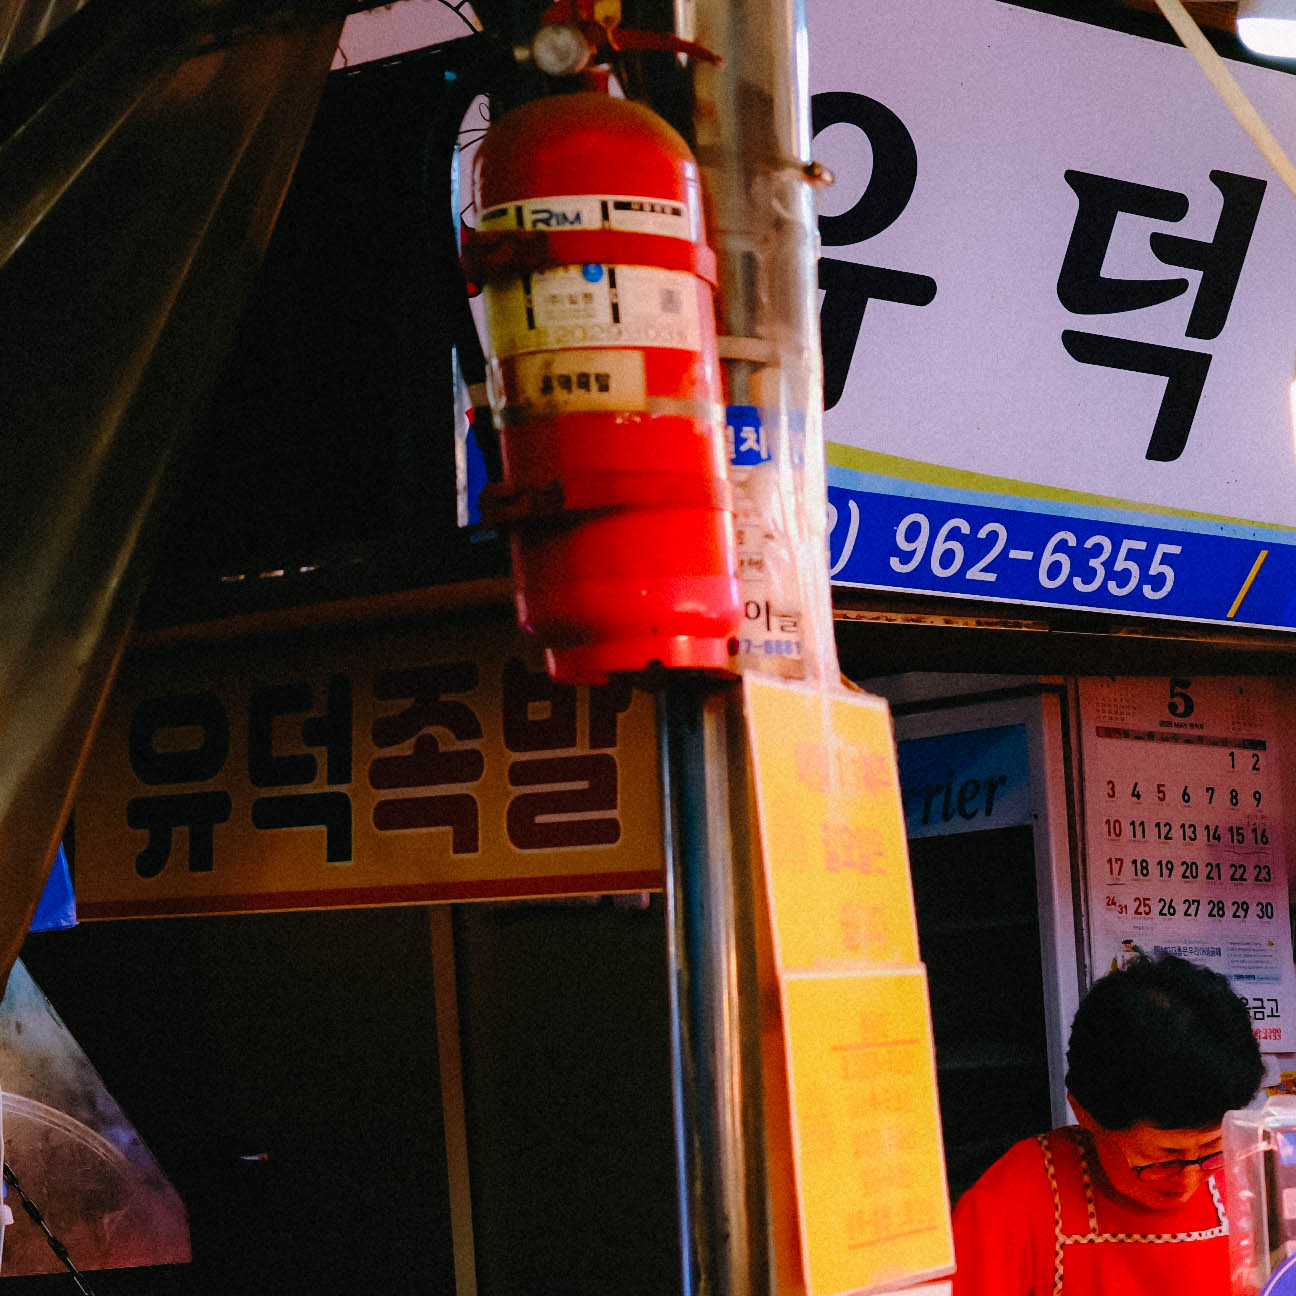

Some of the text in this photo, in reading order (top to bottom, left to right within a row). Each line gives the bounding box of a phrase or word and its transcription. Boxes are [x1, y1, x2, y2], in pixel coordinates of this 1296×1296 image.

[889, 512, 1184, 601] 962-6355
[1167, 678, 1195, 719] 5
[125, 655, 634, 880] 유덕족발
[1228, 751, 1261, 771] 1 2
[1106, 780, 1262, 808] 3 4 5 6 7 8 9
[1104, 818, 1270, 846] 10 11 12 13 14 15 16
[1106, 857, 1272, 883] 17 18 19 20 21 22 23
[1105, 895, 1274, 920] 24 31 25 26 27 28 29 30
